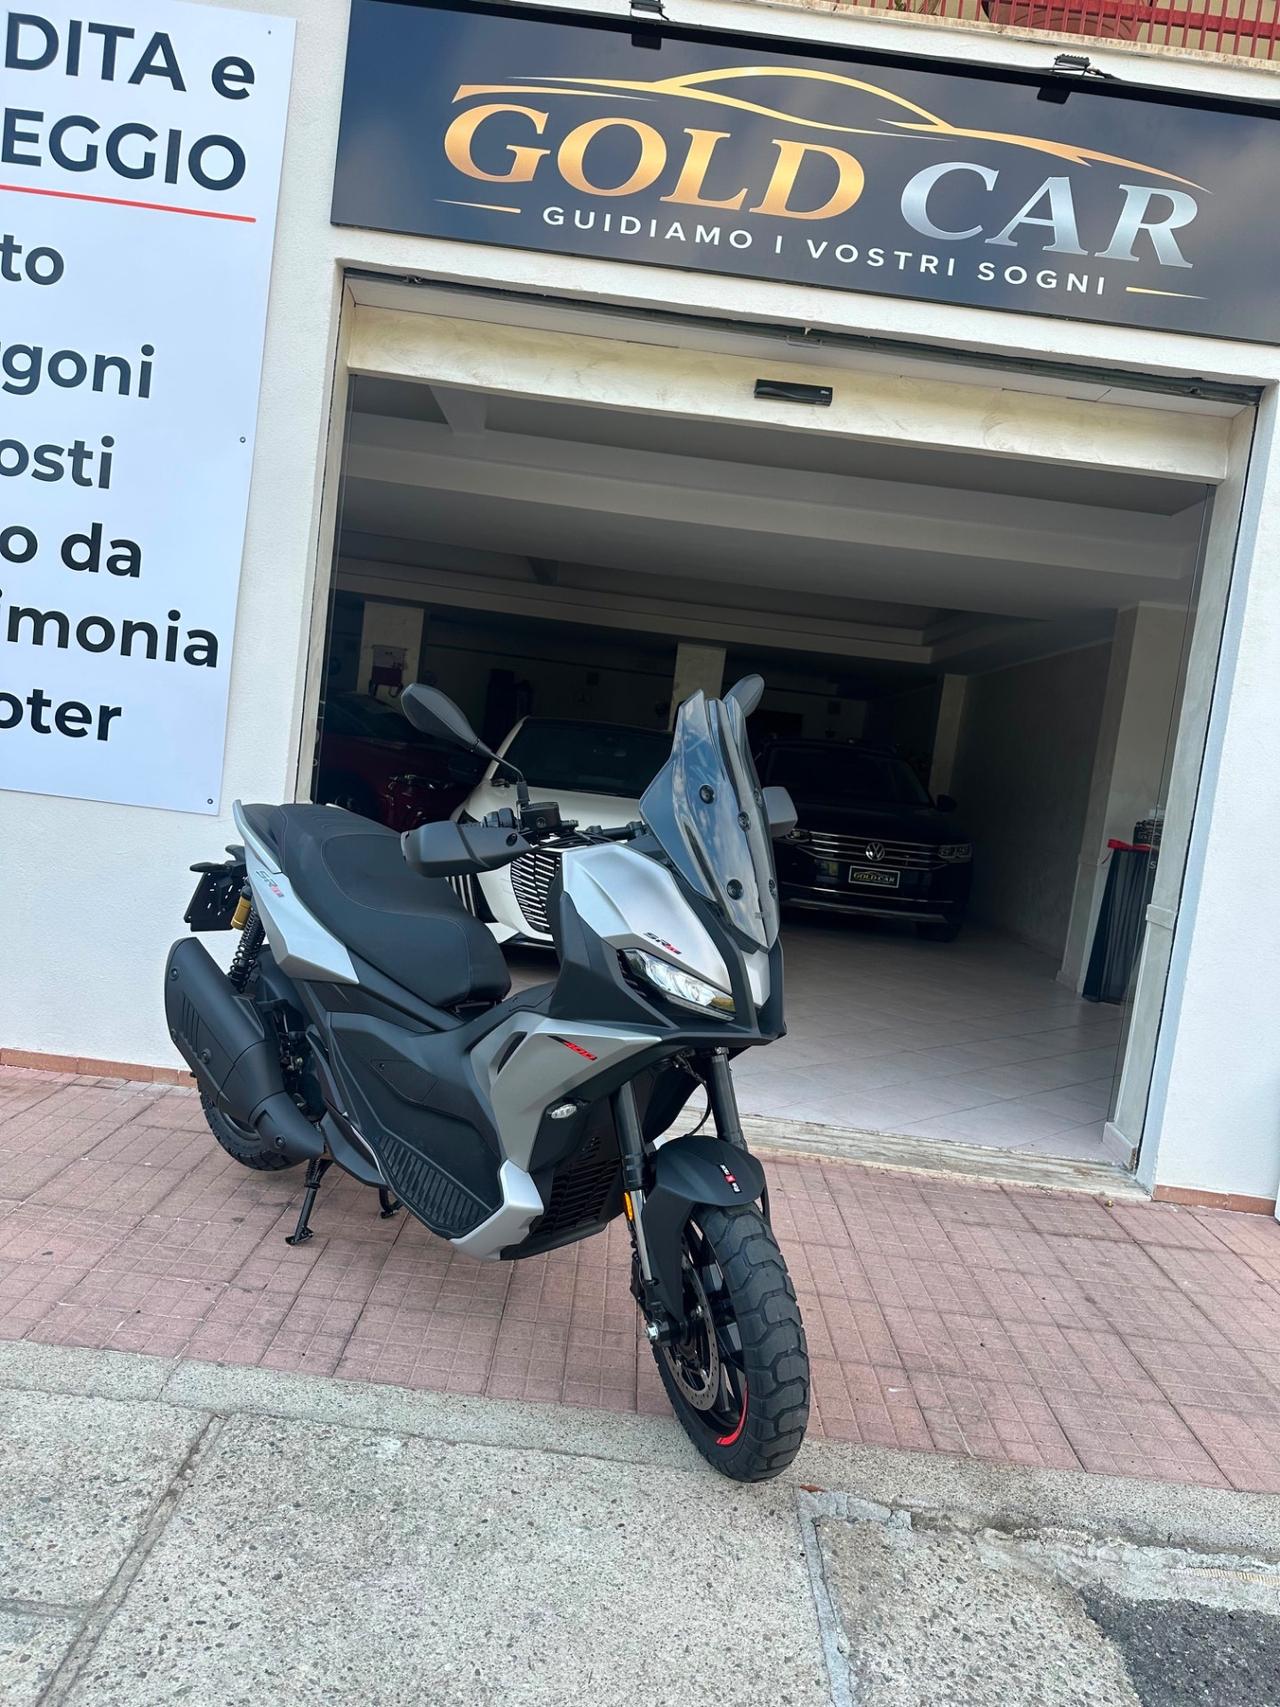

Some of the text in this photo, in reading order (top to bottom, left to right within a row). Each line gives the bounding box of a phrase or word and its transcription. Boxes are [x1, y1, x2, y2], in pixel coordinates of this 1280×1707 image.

[4, 11, 255, 100] DITA e
[0, 107, 246, 191] EGGIO
[443, 102, 1199, 269] GOLD CAR
[0, 233, 65, 286] to
[542, 206, 1105, 296] GUIDIAMO I VOSTRI SOGNI
[0, 344, 155, 399] goni
[0, 435, 115, 490] osti
[60, 522, 142, 578] da
[0, 588, 219, 669] monia
[0, 688, 122, 742] oter
